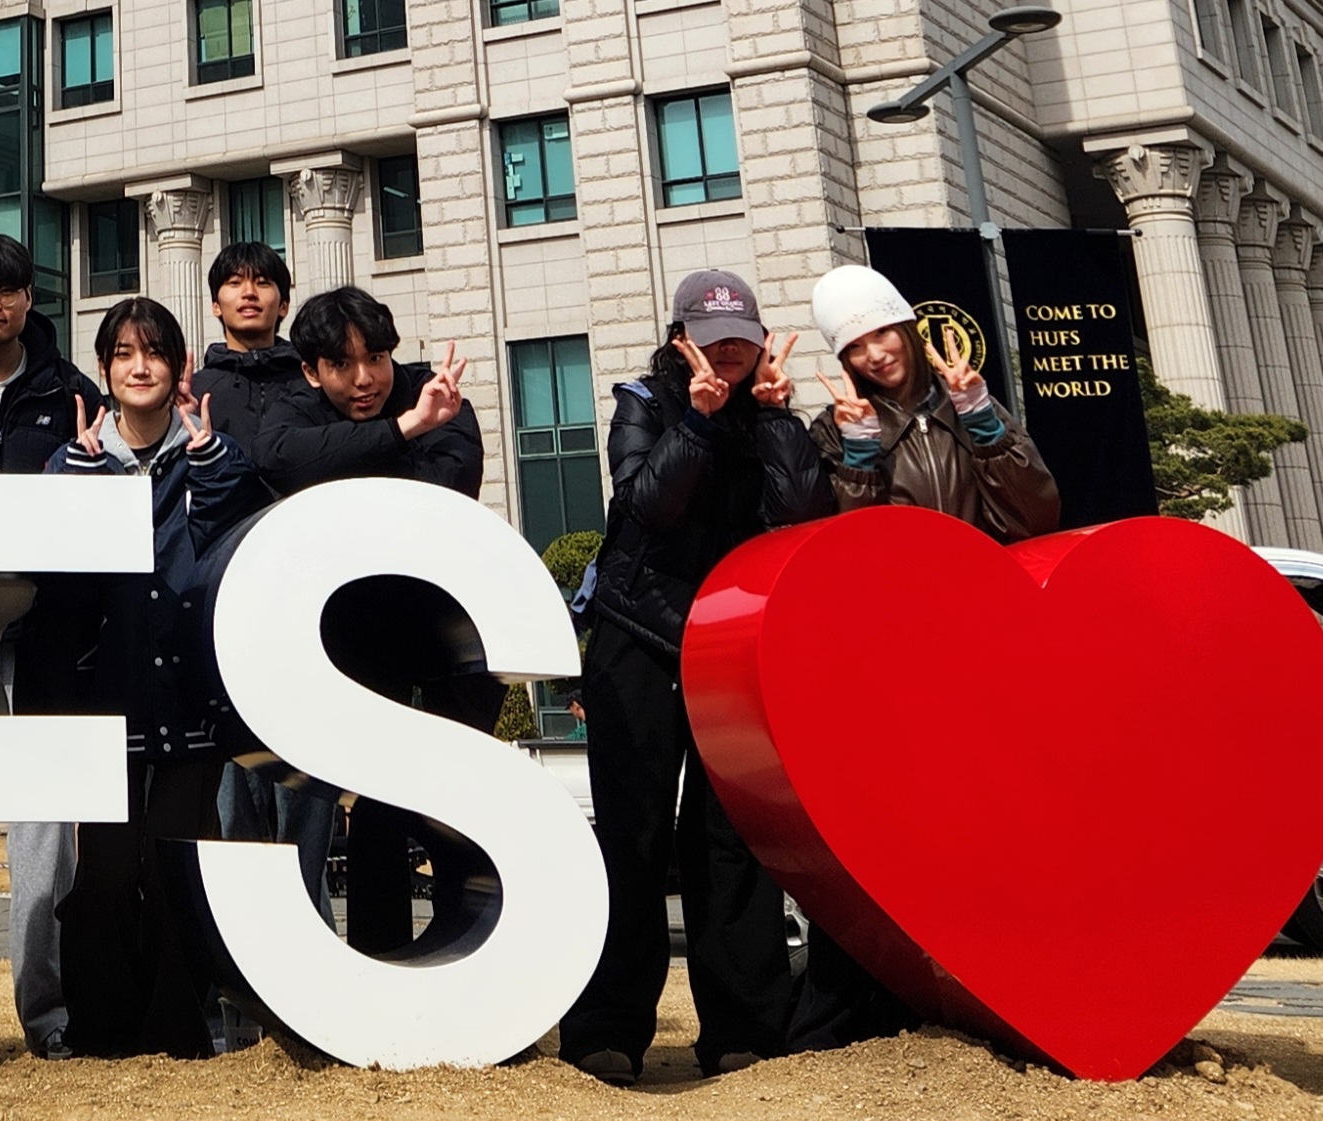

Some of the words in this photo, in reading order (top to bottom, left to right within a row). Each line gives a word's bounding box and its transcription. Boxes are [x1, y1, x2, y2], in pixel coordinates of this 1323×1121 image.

[1026, 305, 1083, 320] COME
[1086, 304, 1116, 319] TO
[1030, 330, 1080, 346] HUFS
[1034, 355, 1083, 372] MEET
[1088, 354, 1129, 370] THE
[1035, 381, 1111, 398] WORLD
